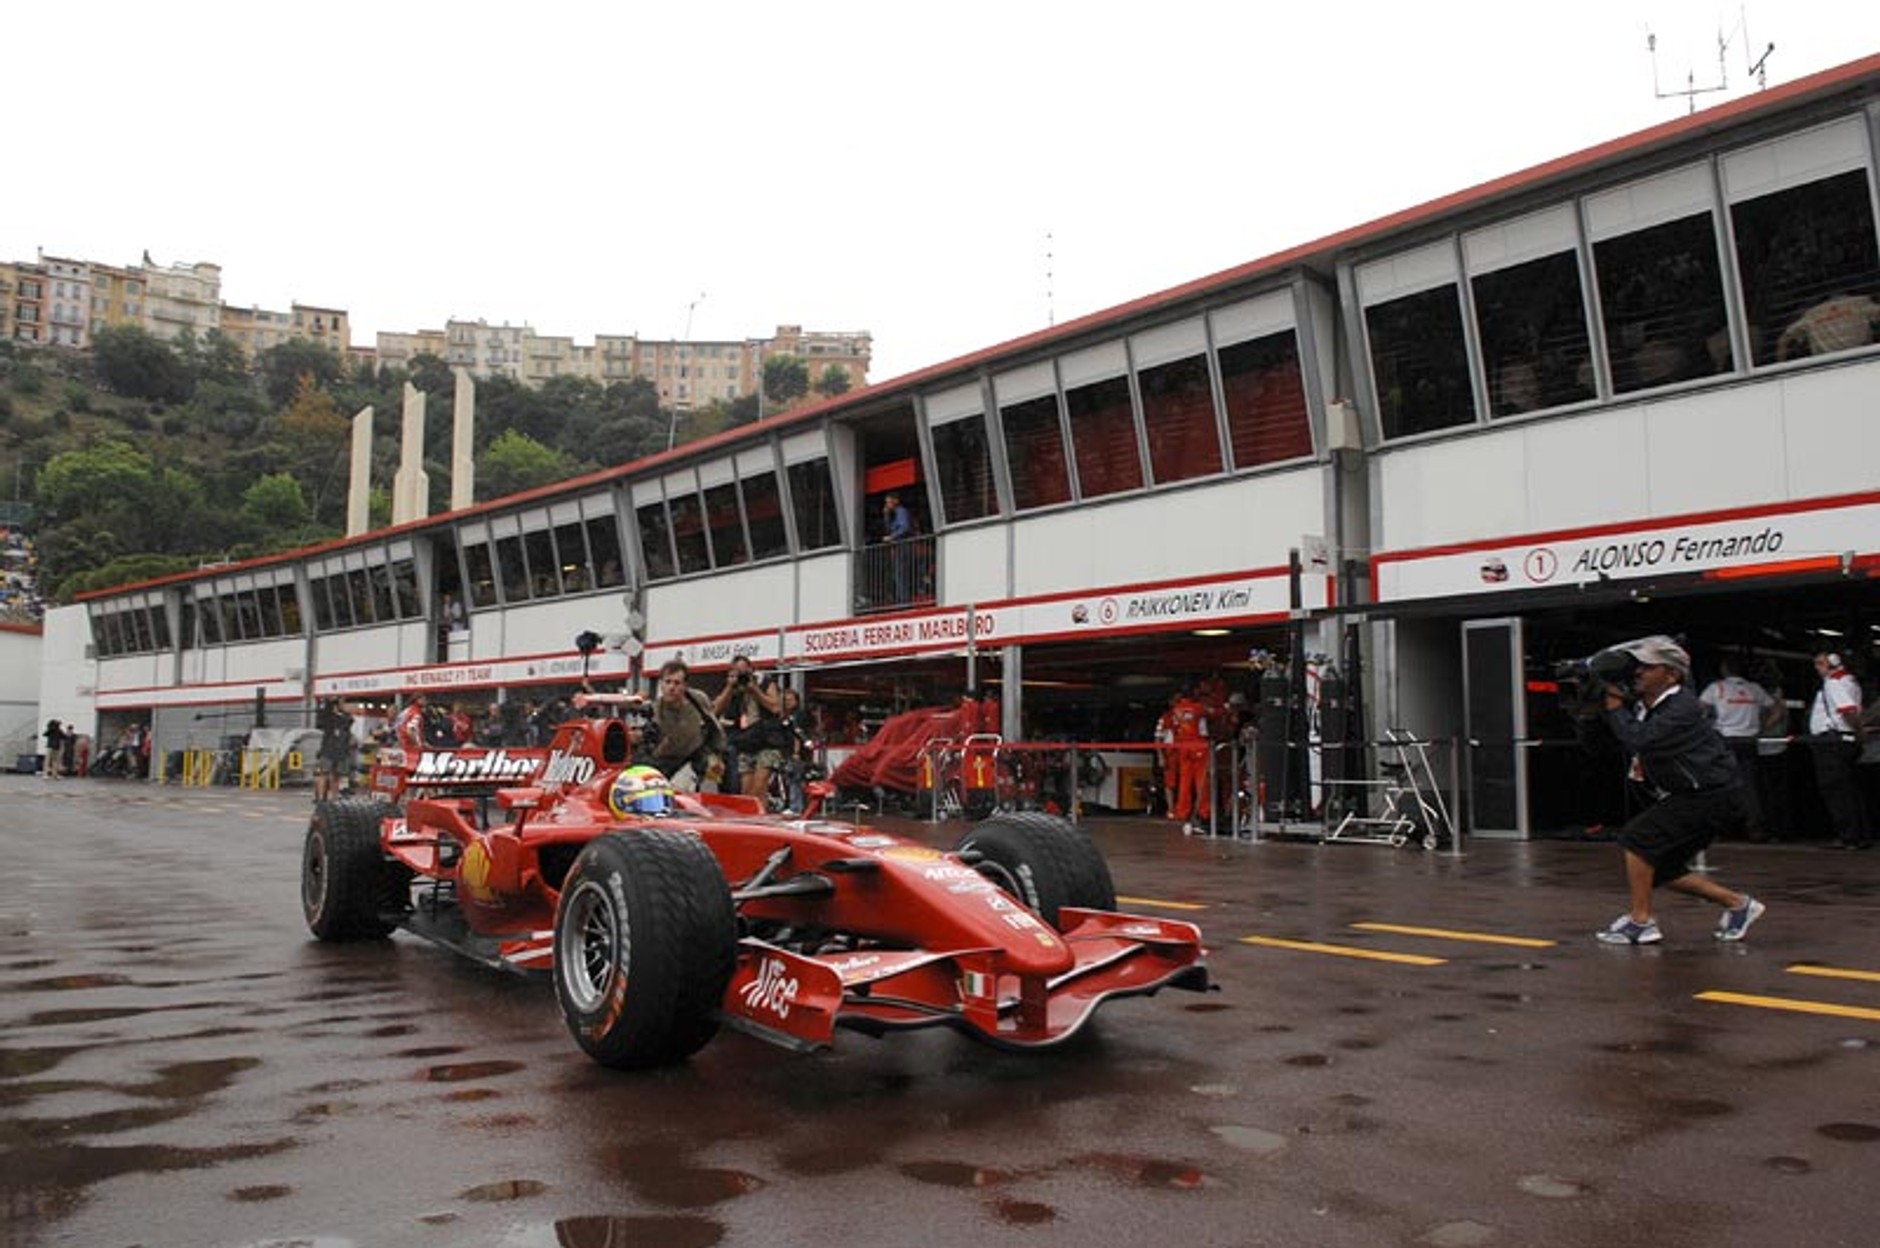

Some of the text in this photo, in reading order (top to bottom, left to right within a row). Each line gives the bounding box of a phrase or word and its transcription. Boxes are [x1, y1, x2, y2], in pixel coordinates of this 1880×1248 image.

[1573, 539, 1666, 573] ALONSO
[1671, 527, 1784, 563] Fernando
[1217, 587, 1252, 608] Kimi
[804, 614, 995, 652] SCUDERIA FERRARI MARLBRO
[739, 957, 798, 1019] Alice
